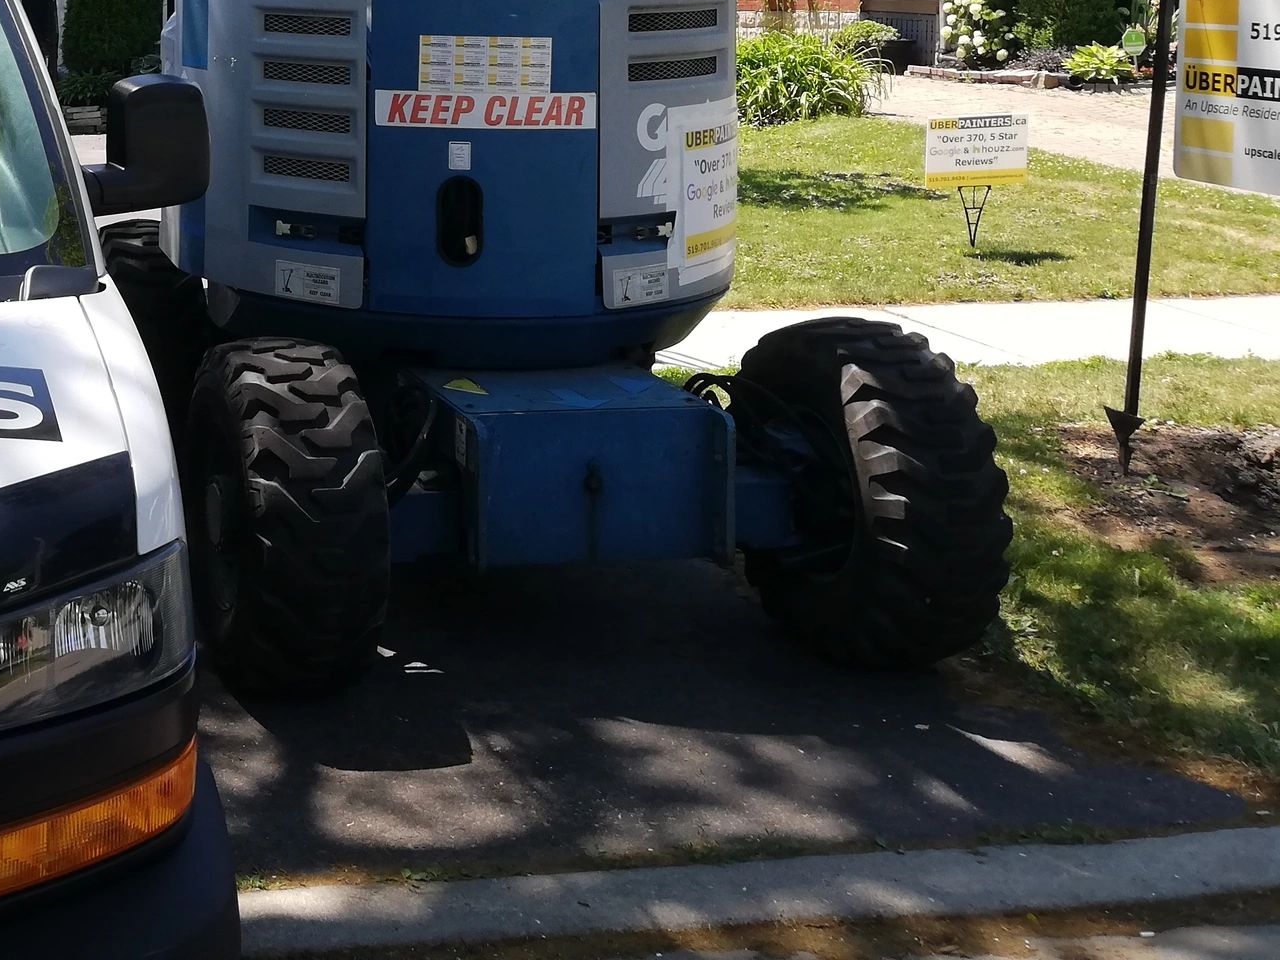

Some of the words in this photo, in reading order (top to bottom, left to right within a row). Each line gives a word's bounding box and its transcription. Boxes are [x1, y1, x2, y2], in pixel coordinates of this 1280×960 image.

[387, 93, 475, 125] KEEP
[484, 95, 586, 126] CLEAR
[1184, 99, 1197, 112] An
[1201, 101, 1238, 116] Upscale
[966, 134, 986, 142] 370,
[990, 133, 995, 141] 5
[998, 132, 1018, 140] Star
[930, 147, 960, 157] Google
[687, 179, 718, 201] Google
